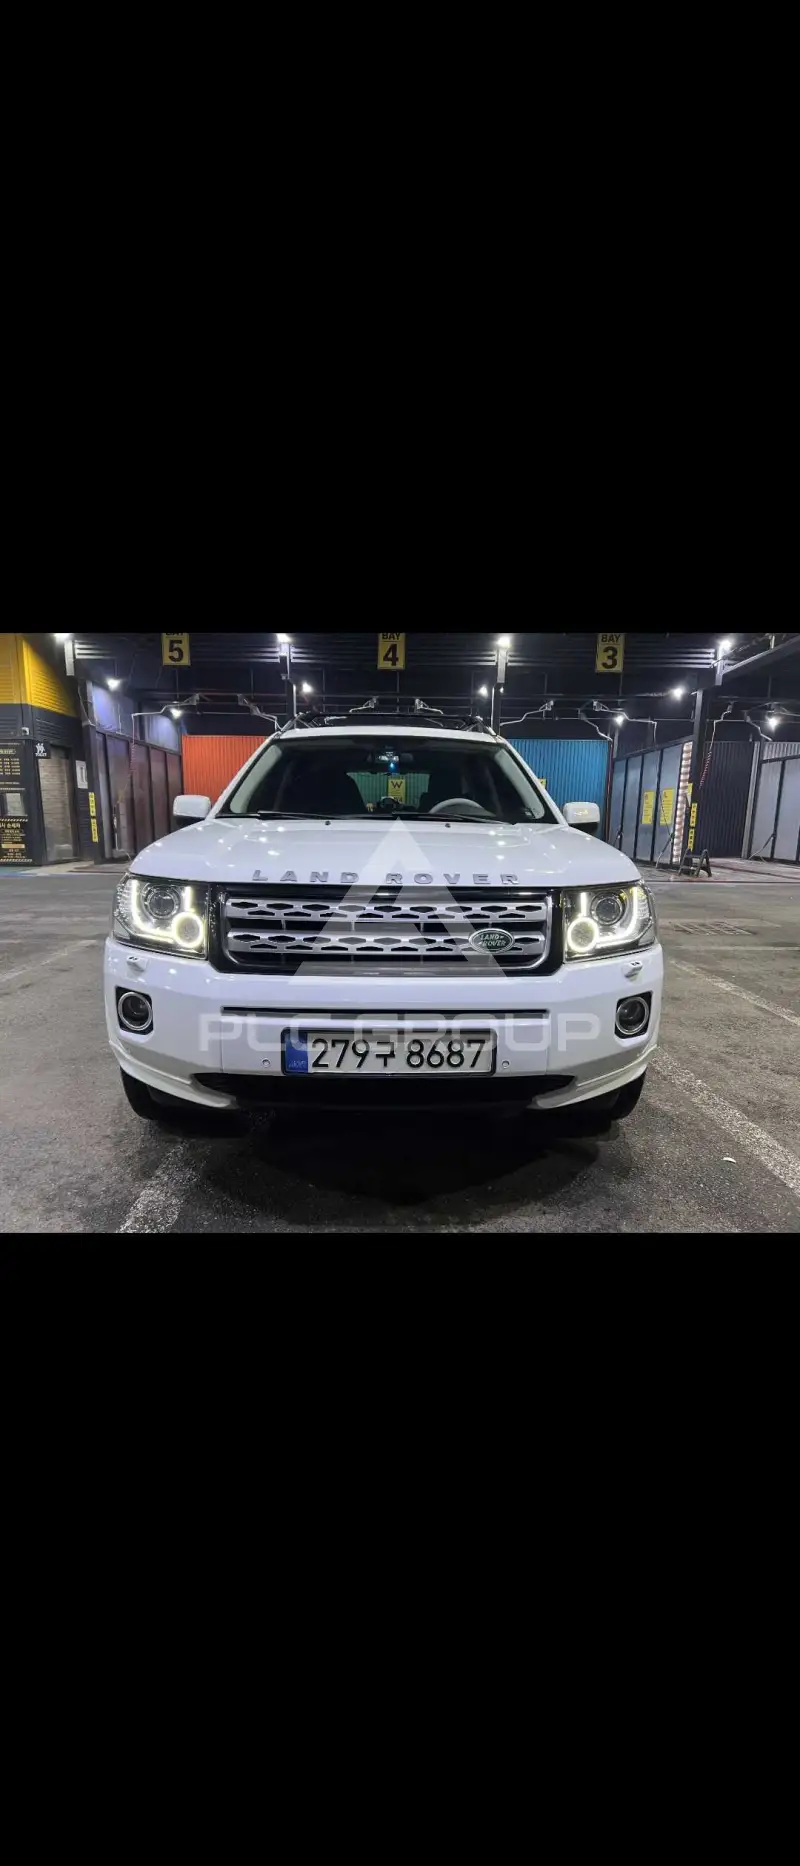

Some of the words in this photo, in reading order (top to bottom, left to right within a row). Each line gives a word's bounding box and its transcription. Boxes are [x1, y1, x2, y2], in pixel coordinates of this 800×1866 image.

[601, 634, 620, 643] BAY
[168, 639, 184, 662] 5
[383, 643, 399, 667] 4
[602, 645, 618, 669] 3
[252, 869, 360, 883] LAND
[385, 872, 520, 885] ROVER
[480, 933, 500, 941] LAND
[482, 939, 507, 948] ROVER
[406, 1038, 486, 1068] 8687
